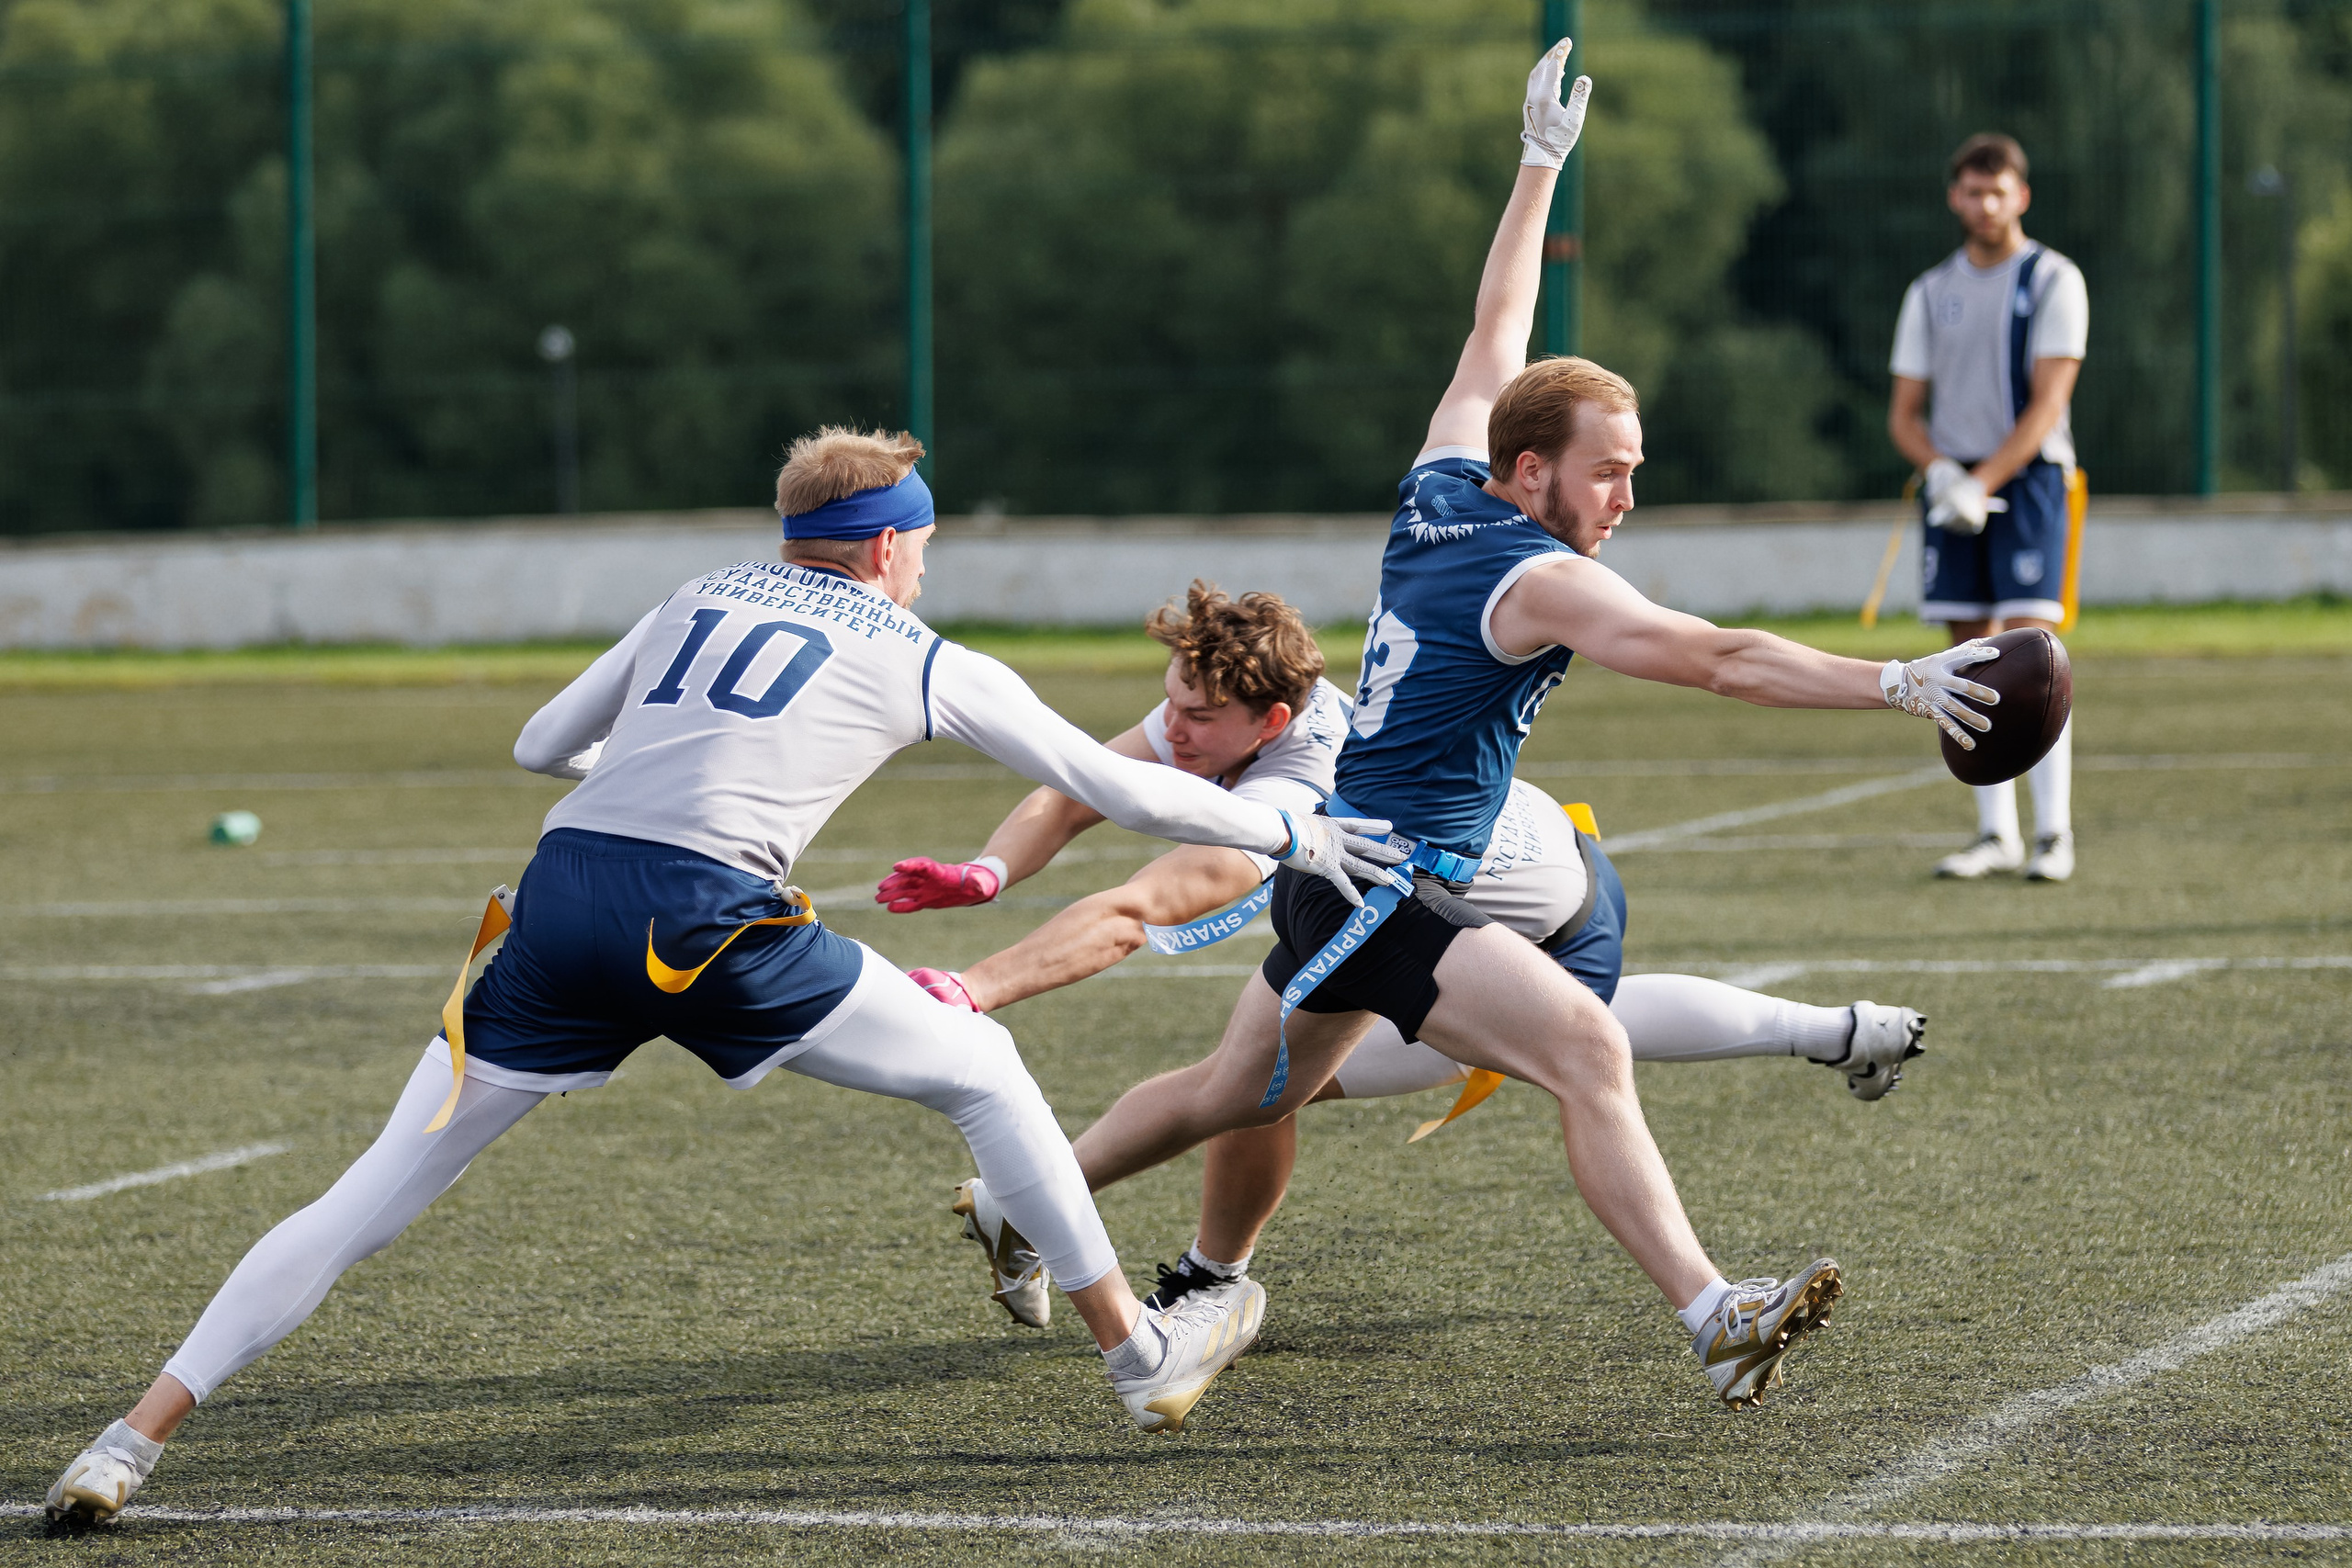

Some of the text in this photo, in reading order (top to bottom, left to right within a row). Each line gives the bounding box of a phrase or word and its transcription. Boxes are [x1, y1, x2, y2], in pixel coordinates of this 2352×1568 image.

[696, 582, 881, 639] УНИВЕРСИТЕТ
[639, 607, 837, 722] 10
[1157, 912, 1243, 950] SHARKS
[1297, 905, 1379, 983] CAPITAL
